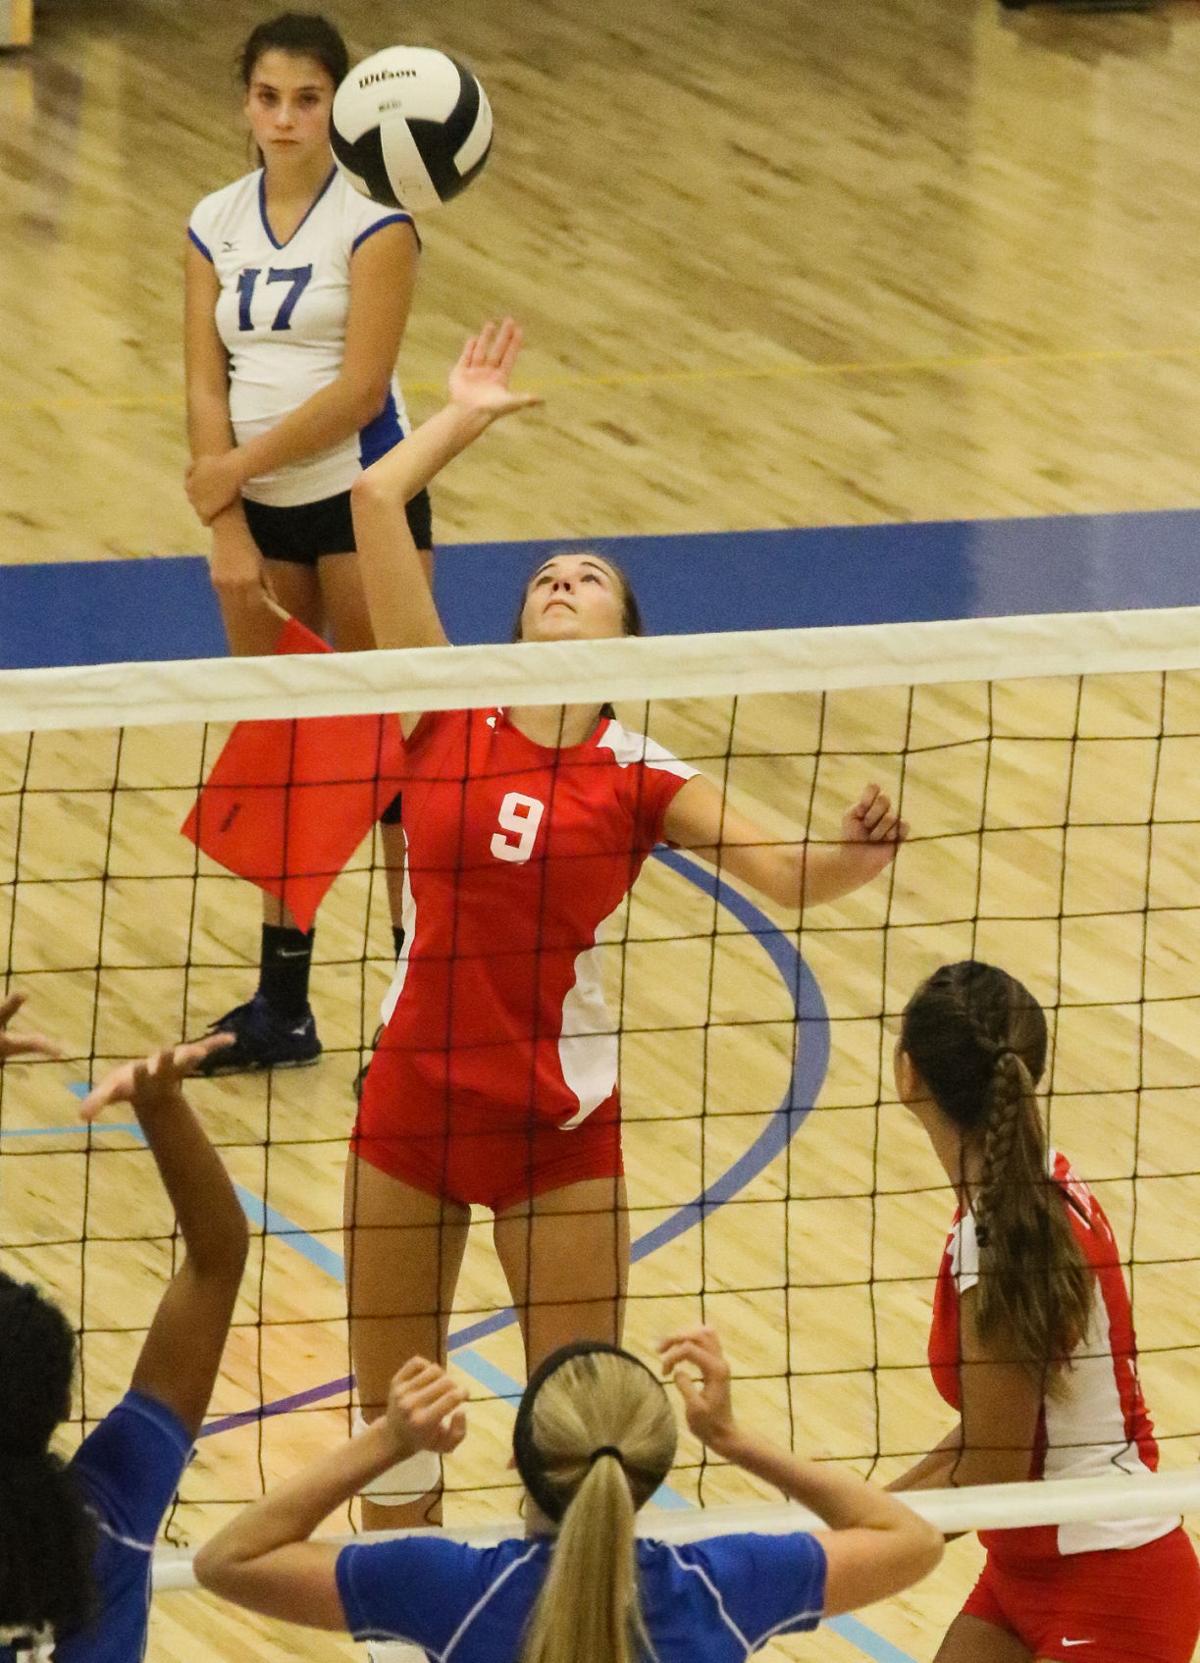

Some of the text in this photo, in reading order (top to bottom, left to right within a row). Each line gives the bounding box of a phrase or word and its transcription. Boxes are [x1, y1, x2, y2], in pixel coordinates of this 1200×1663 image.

[358, 69, 417, 89] Wilson
[236, 263, 313, 331] 17
[490, 792, 544, 865] 9
